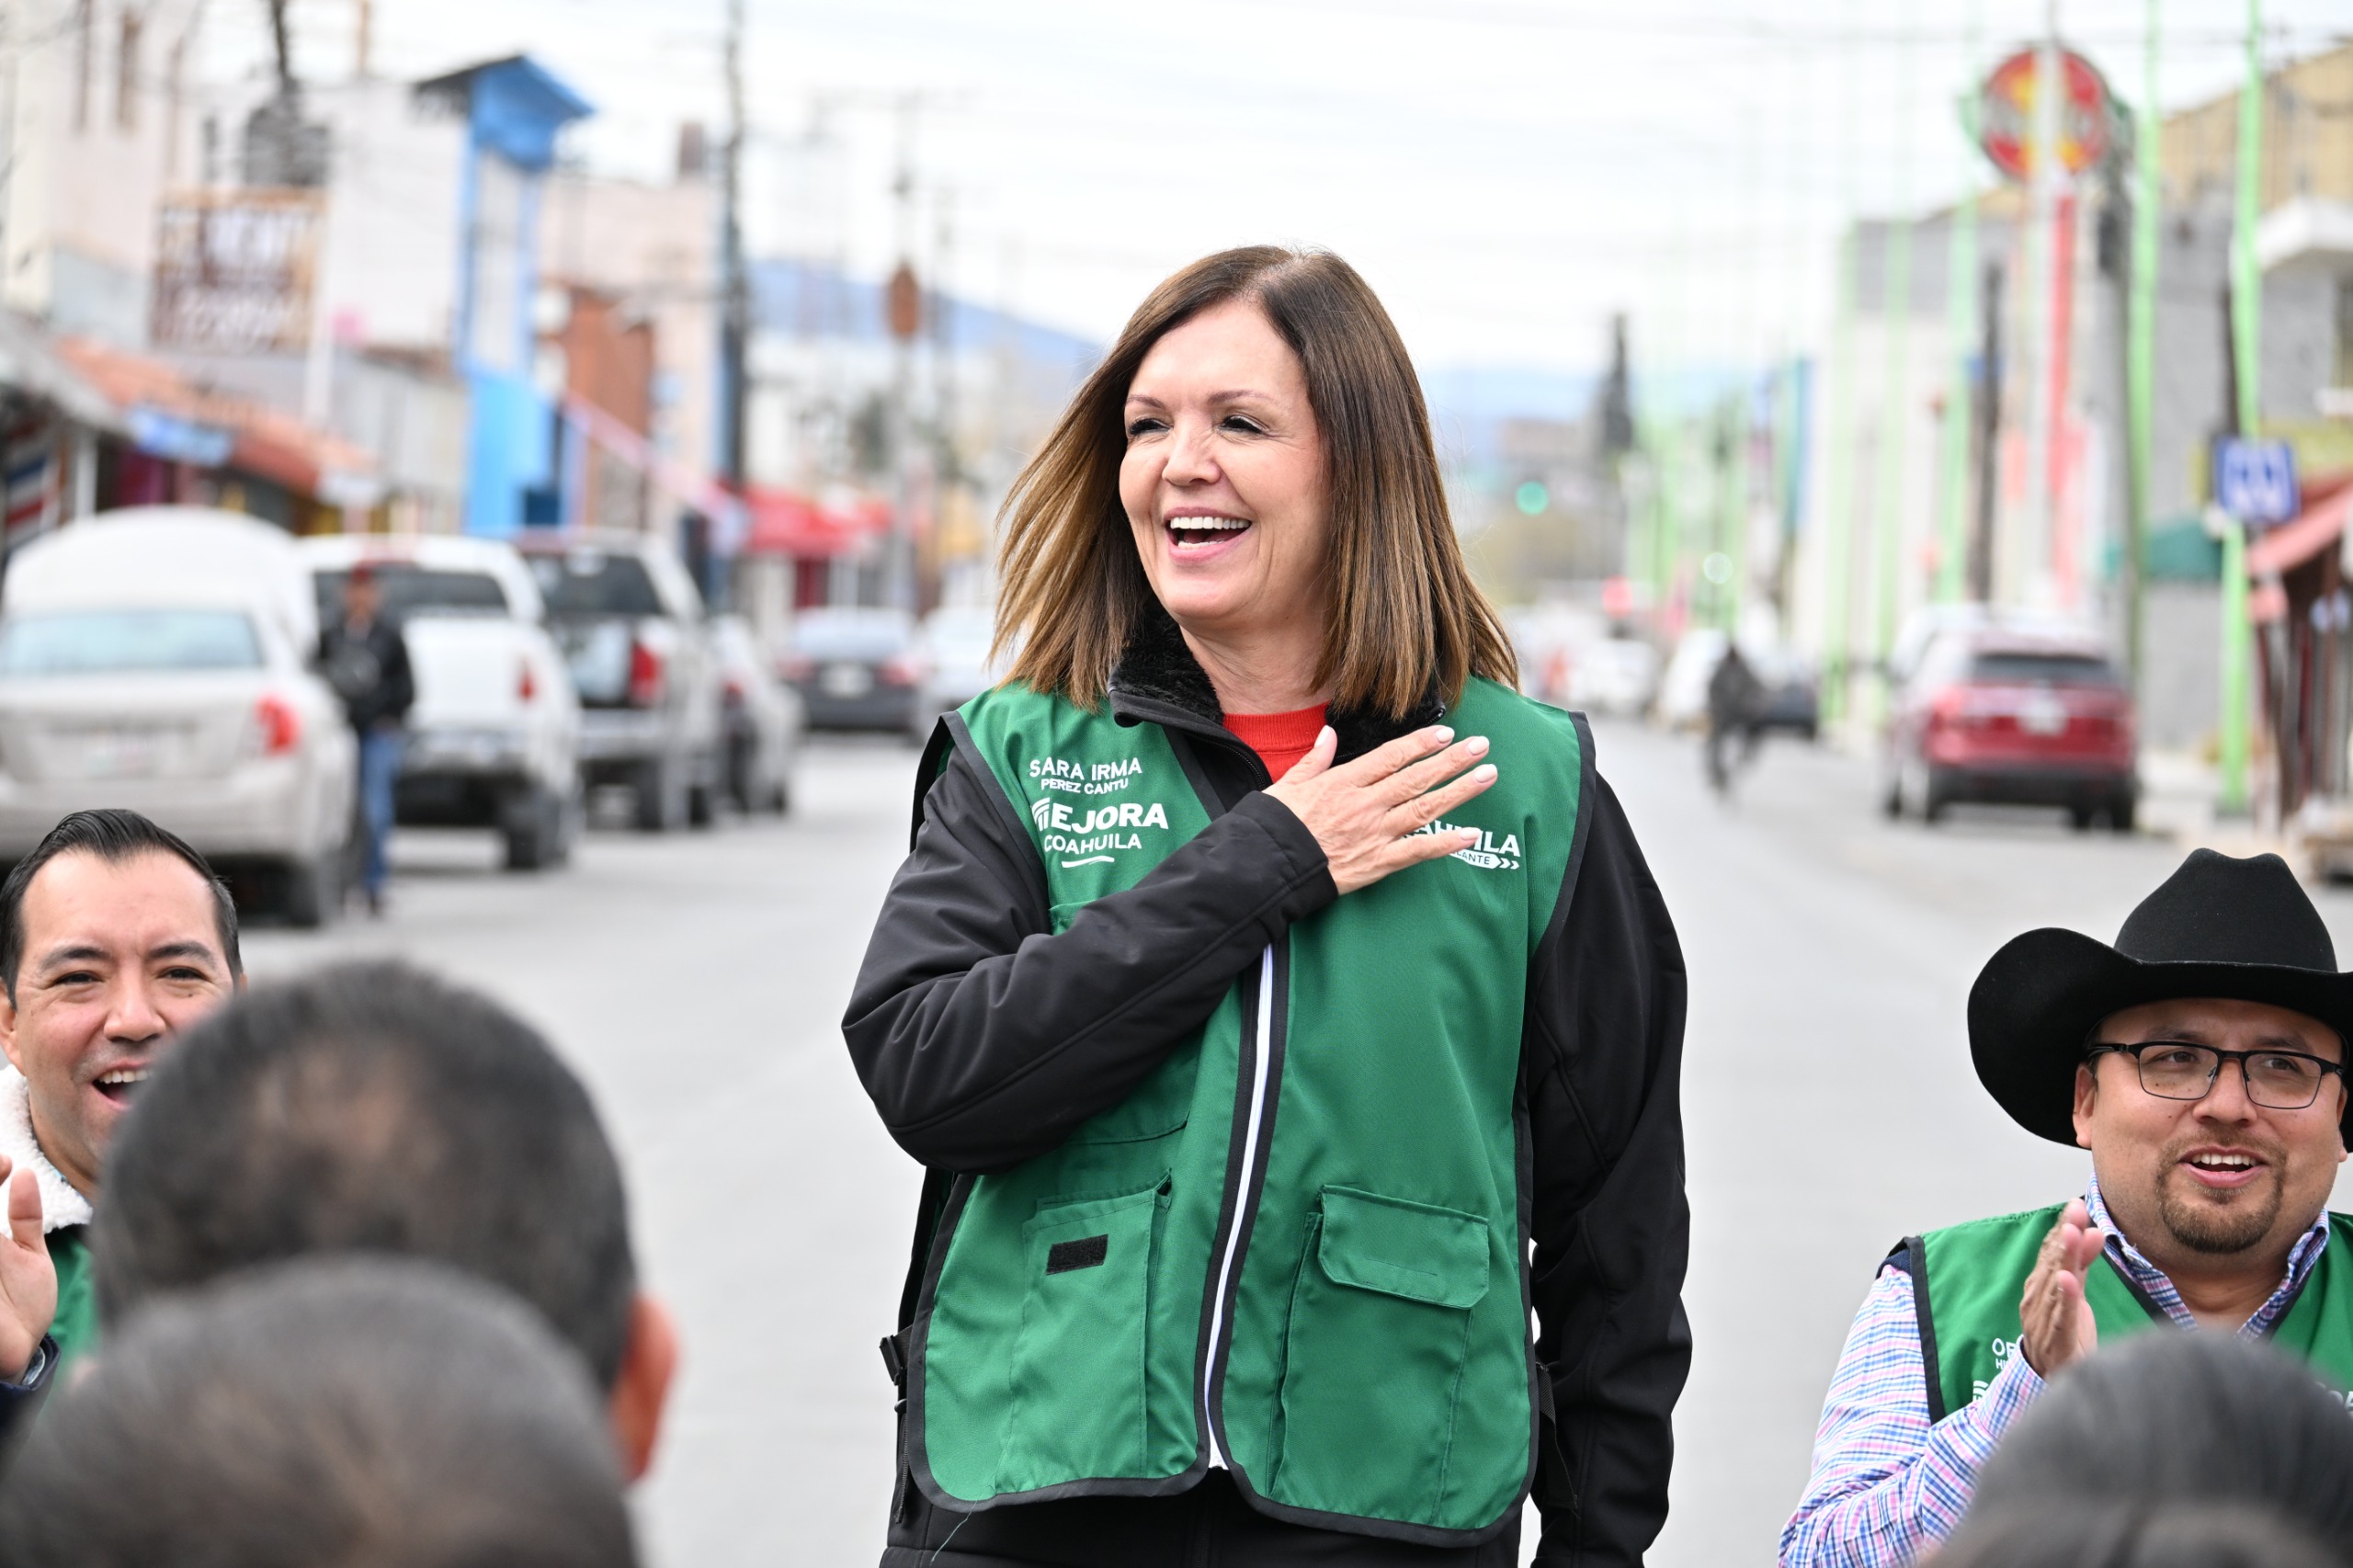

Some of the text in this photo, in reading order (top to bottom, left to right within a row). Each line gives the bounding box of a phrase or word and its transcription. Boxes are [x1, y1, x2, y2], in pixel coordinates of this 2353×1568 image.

[1029, 756, 1142, 781] SARA IRMA
[1040, 778, 1129, 795] PEREZ CANTU
[1044, 833, 1142, 855] COAHUILA
